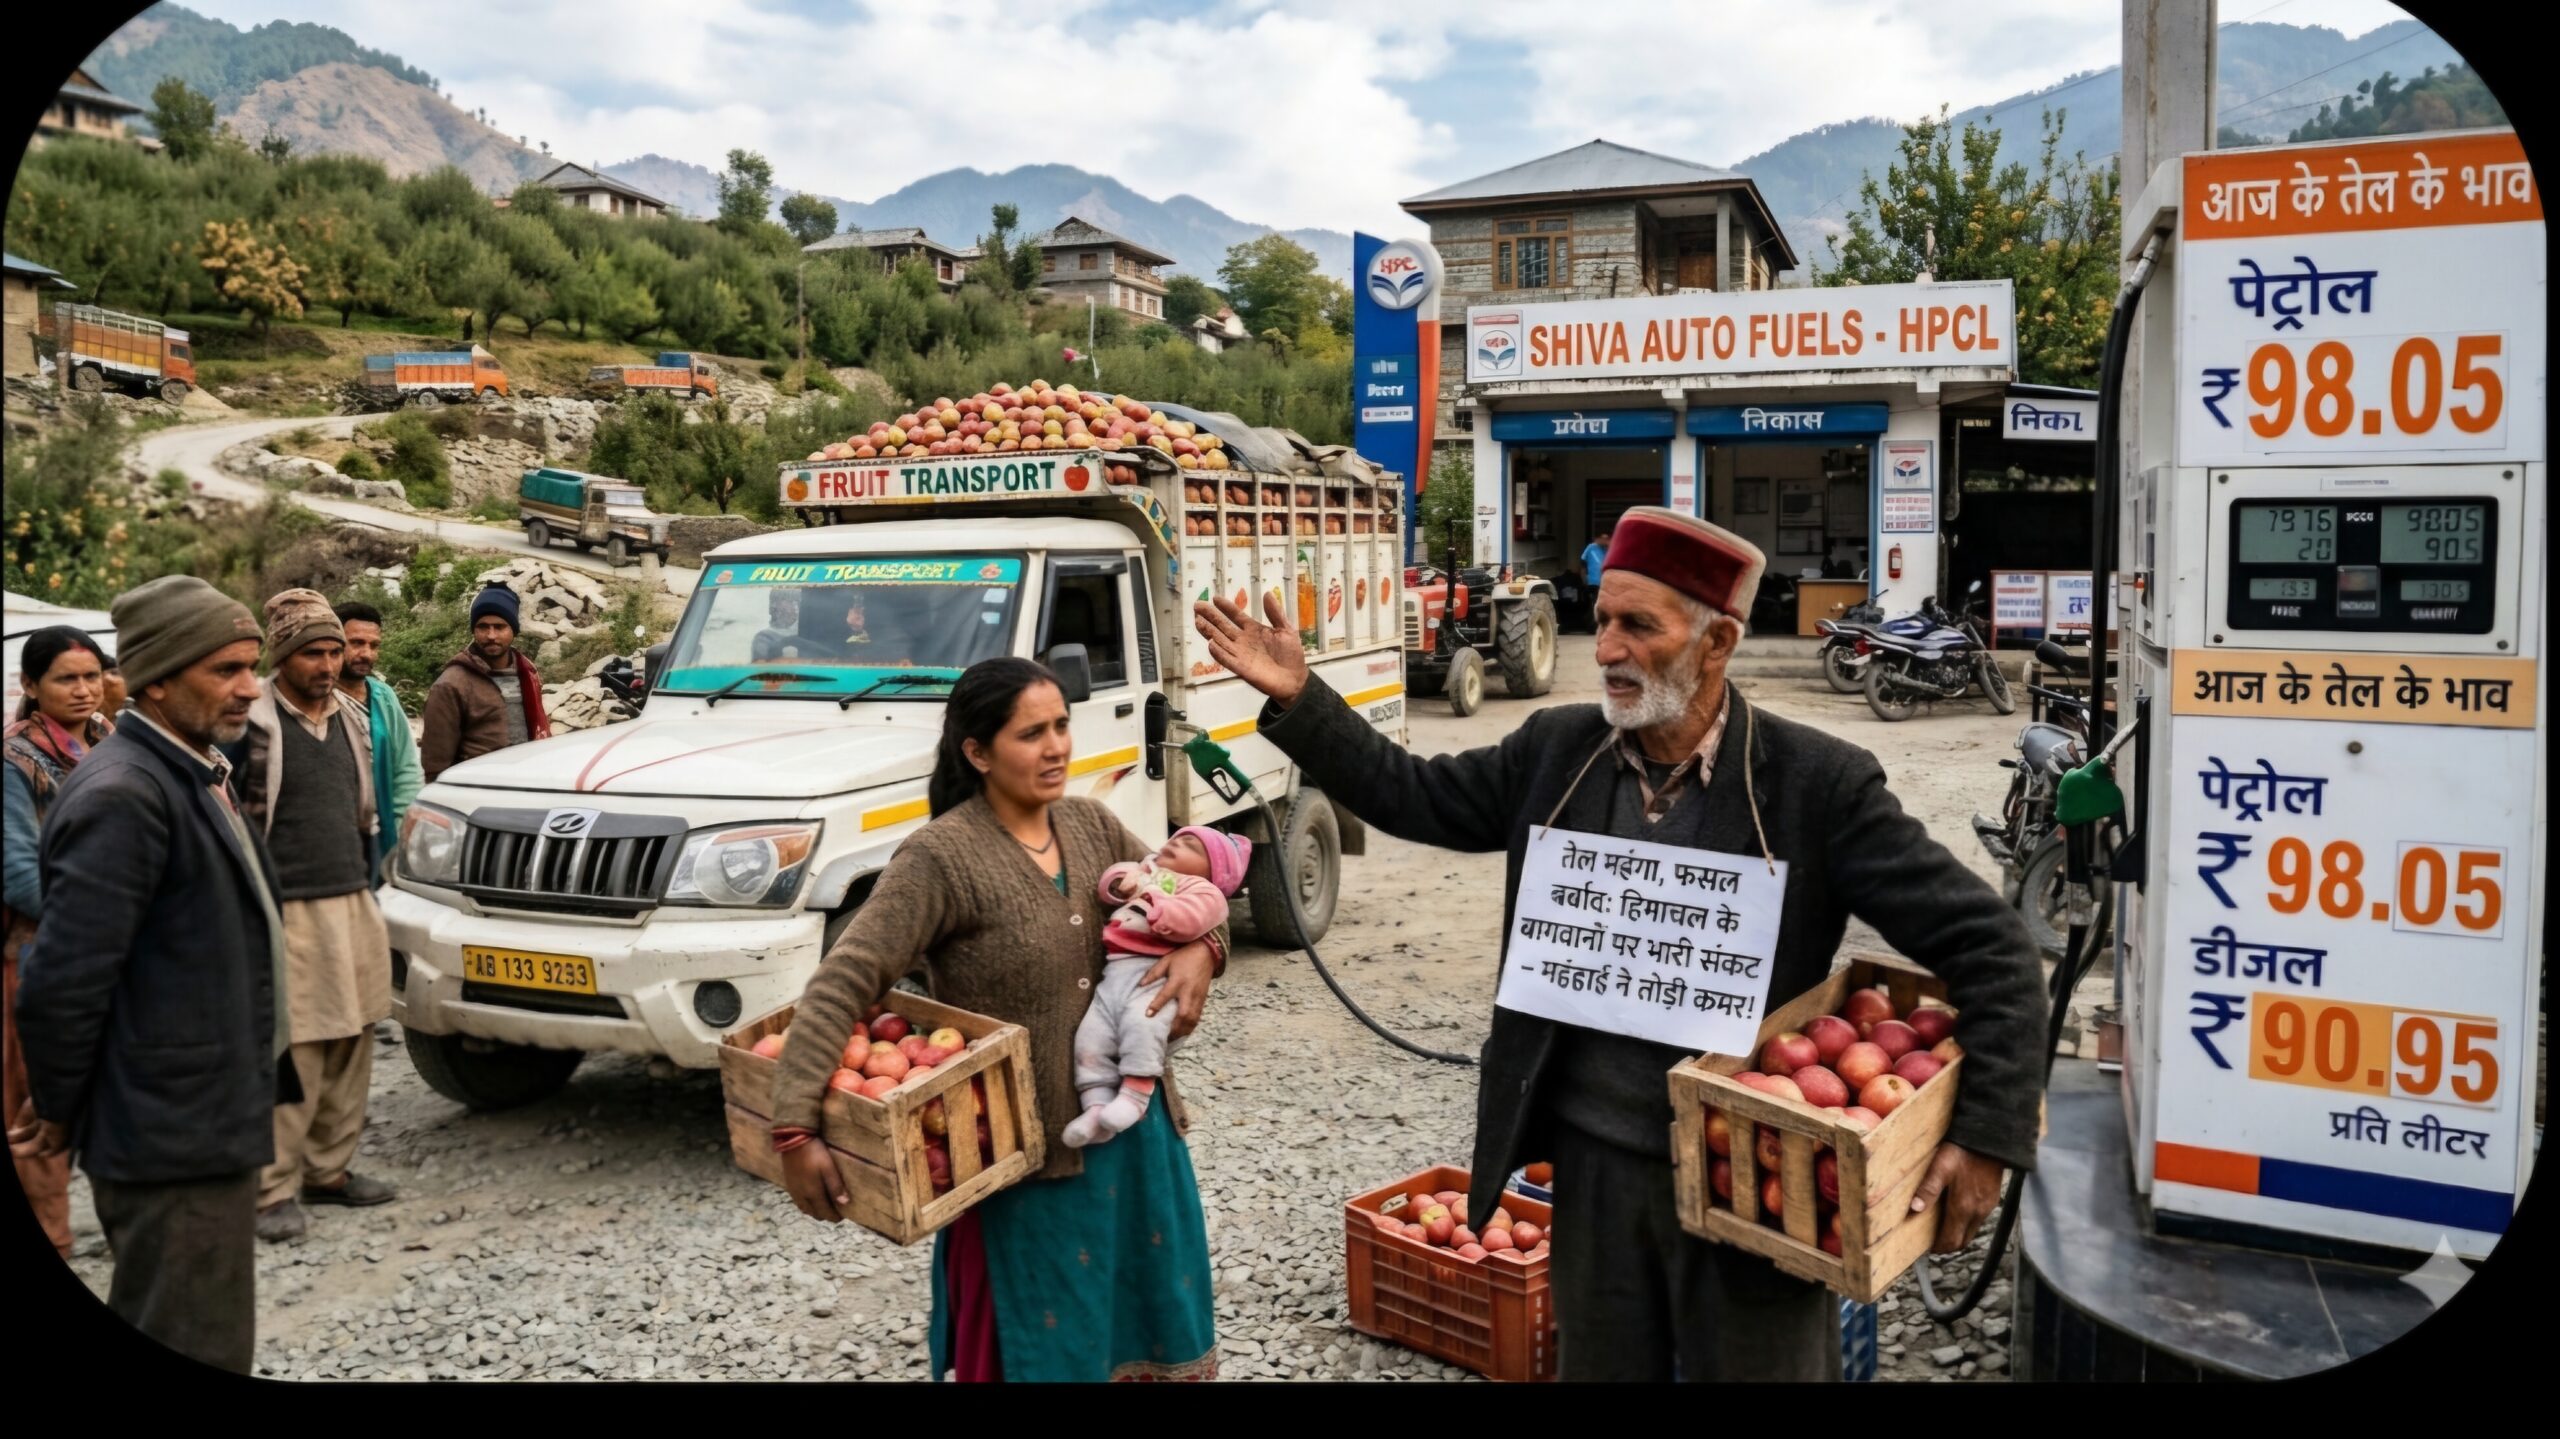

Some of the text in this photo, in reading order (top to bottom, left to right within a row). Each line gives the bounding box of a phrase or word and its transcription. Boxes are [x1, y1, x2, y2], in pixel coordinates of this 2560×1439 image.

[2202, 153, 2533, 222] आज के तेल के भाव
[2229, 256, 2378, 330] पेट्रोल
[1530, 321, 1630, 367] SHIVA
[1642, 315, 1736, 363] AUTO
[1749, 309, 1864, 358] FUELS
[1900, 304, 1999, 353] HPCL
[1741, 407, 1824, 432] निकास
[818, 461, 1056, 498] FRUIT TRANSPORT
[2194, 661, 2513, 713] आज के तेल के भाव
[2198, 756, 2328, 822] पेट्रोल
[1562, 840, 1598, 872] तेल
[1674, 863, 1742, 894] फसल
[1716, 904, 1741, 934] के
[502, 957, 535, 981] 133
[1612, 933, 1641, 959] पर
[1648, 937, 1694, 968] भारी
[1700, 944, 1763, 979] संकट
[2190, 926, 2327, 988] डीजल
[1615, 967, 1633, 996] ने
[1638, 972, 1688, 1010] तोड़ी
[1693, 988, 1756, 1019] कमर!
[2329, 1106, 2490, 1160] प्रति लीटर
